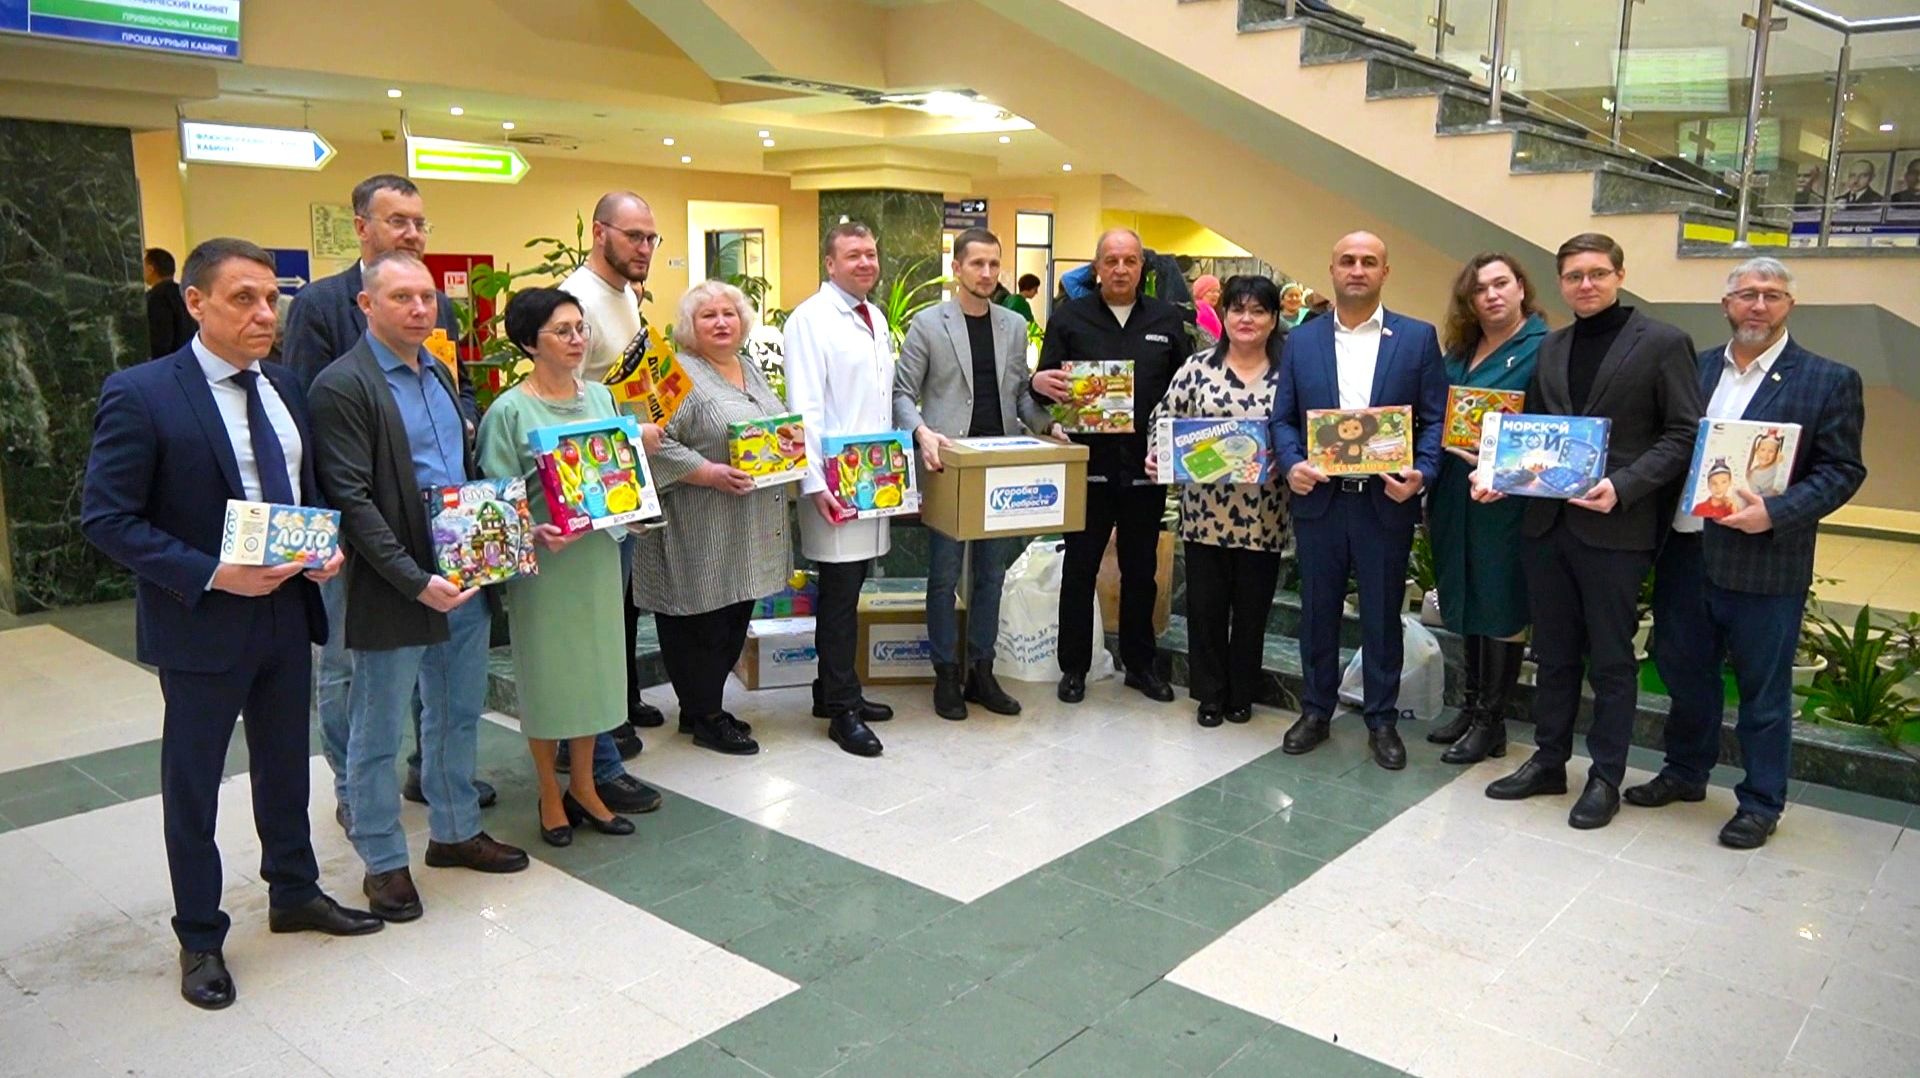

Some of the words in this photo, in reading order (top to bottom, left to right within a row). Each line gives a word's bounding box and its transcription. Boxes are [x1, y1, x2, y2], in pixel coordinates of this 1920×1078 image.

[192, 3, 228, 14] КАБИНЕТ
[122, 12, 189, 29] ПРИВИВОЧНЫЙ
[191, 22, 228, 33] КАБИНЕТ
[121, 32, 189, 49] ПРОЦЕДУРНЫЙ
[190, 41, 228, 53] КАБИНЕТ
[1503, 421, 1570, 434] МОРСКОЙ
[992, 486, 1039, 507] Коробка
[1001, 495, 1050, 511] Храбрости
[274, 526, 331, 550] ЛОТО
[1028, 649, 1056, 664] пласт
